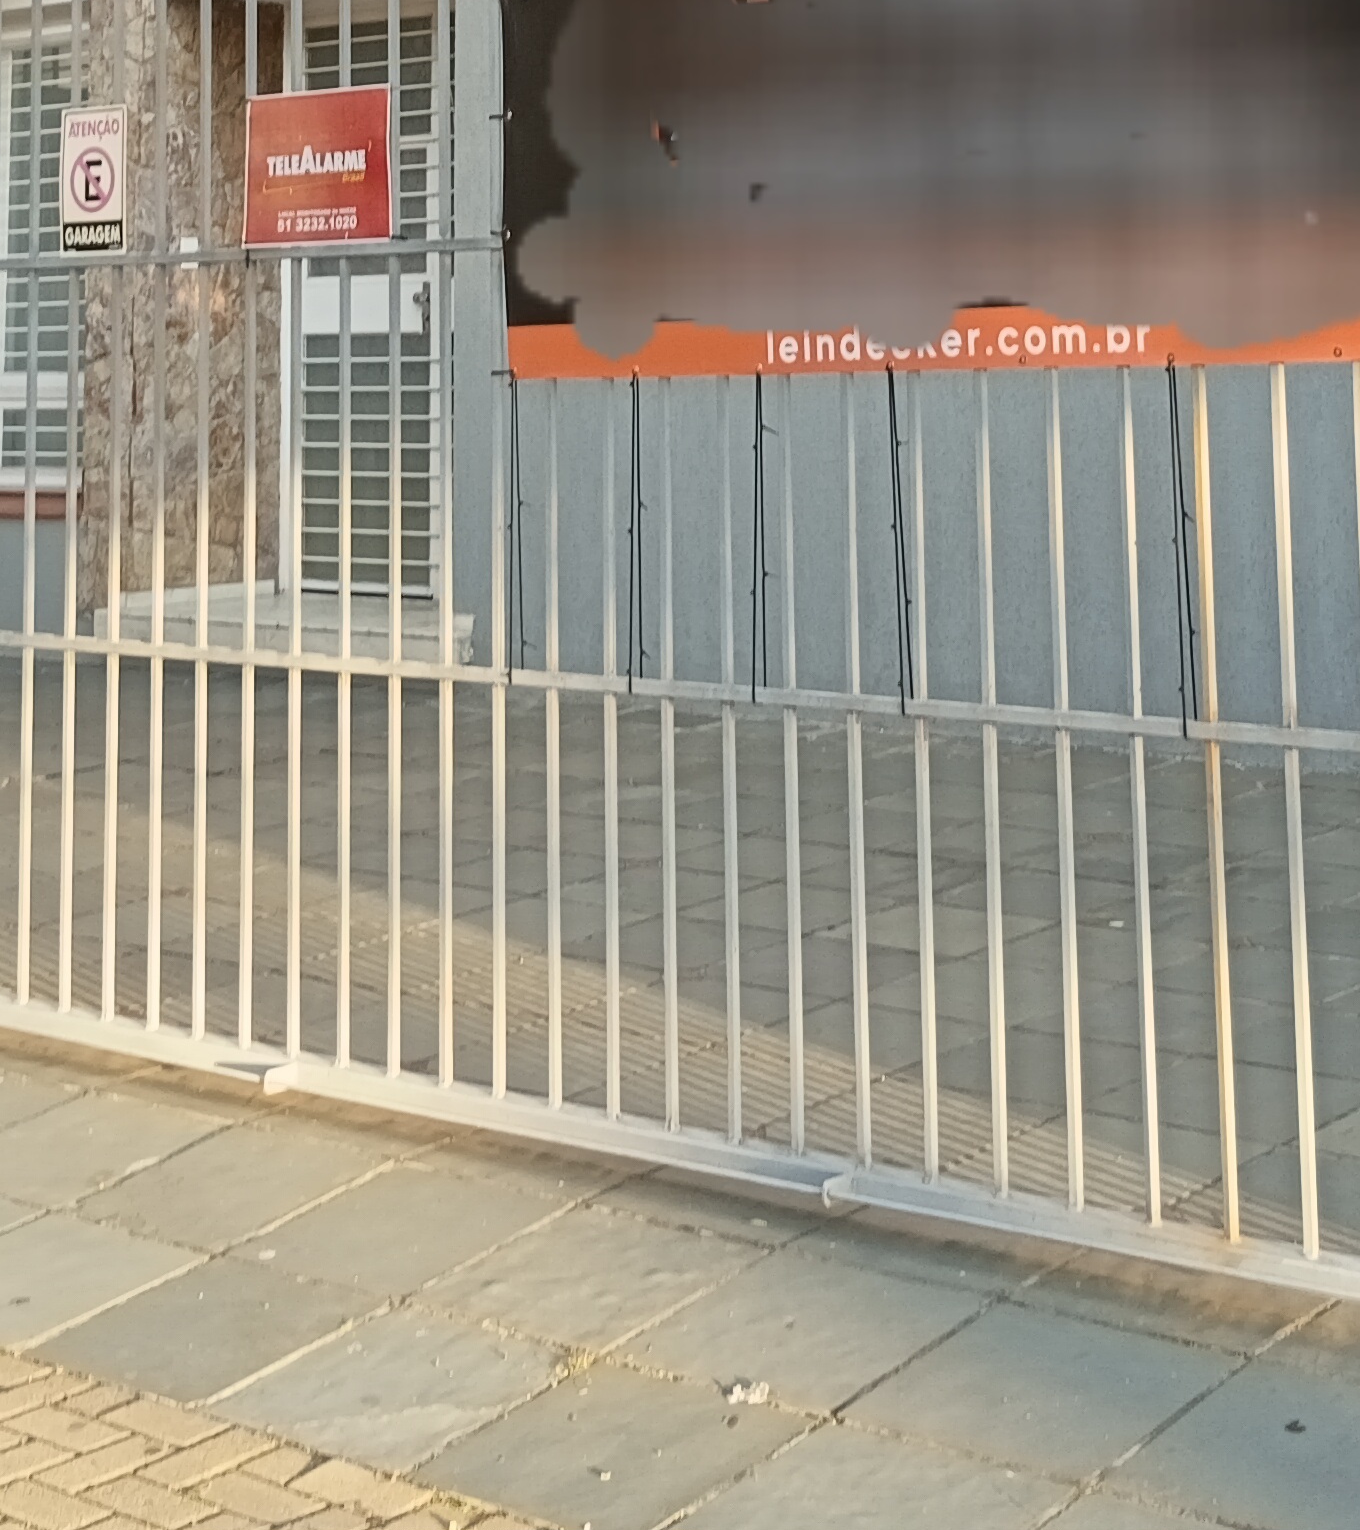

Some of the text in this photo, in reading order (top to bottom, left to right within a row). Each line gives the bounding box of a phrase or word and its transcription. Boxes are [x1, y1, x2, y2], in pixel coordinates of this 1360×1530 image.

[68, 115, 120, 141] ATENÇÃO
[65, 223, 121, 246] GARAGEM
[295, 214, 358, 233] 3232.1020
